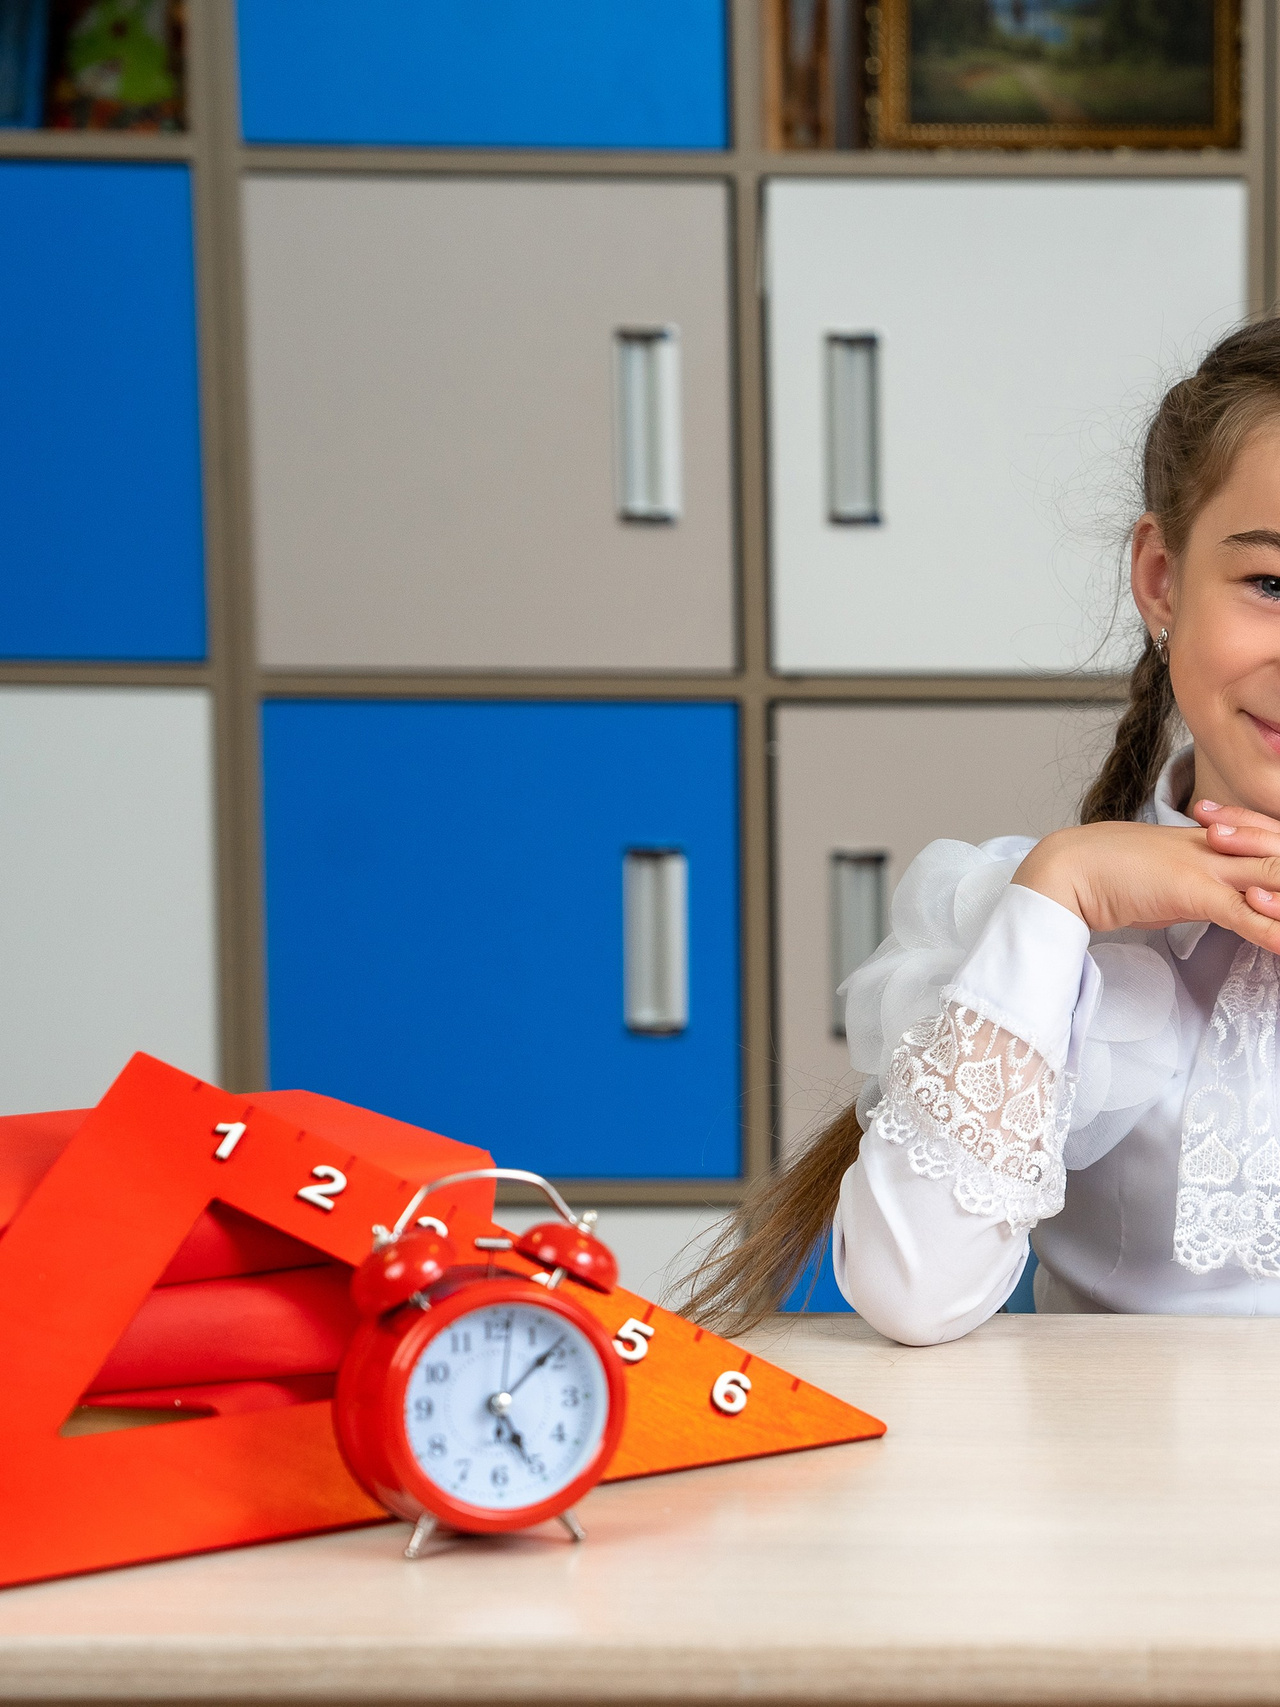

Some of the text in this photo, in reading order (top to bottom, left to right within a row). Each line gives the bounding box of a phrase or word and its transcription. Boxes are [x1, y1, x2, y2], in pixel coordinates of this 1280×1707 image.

[214, 1121, 247, 1160] 1
[297, 1165, 348, 1211] 2
[451, 1331, 472, 1353] 11
[528, 1326, 537, 1346] 1
[611, 1317, 655, 1362] 5
[426, 1363, 450, 1384] 10
[563, 1386, 580, 1408] 3
[711, 1370, 753, 1414] 6
[415, 1396, 434, 1420] 9
[551, 1423, 567, 1443] 4
[428, 1435, 447, 1457] 8
[454, 1458, 472, 1480] 7
[491, 1466, 509, 1487] 6
